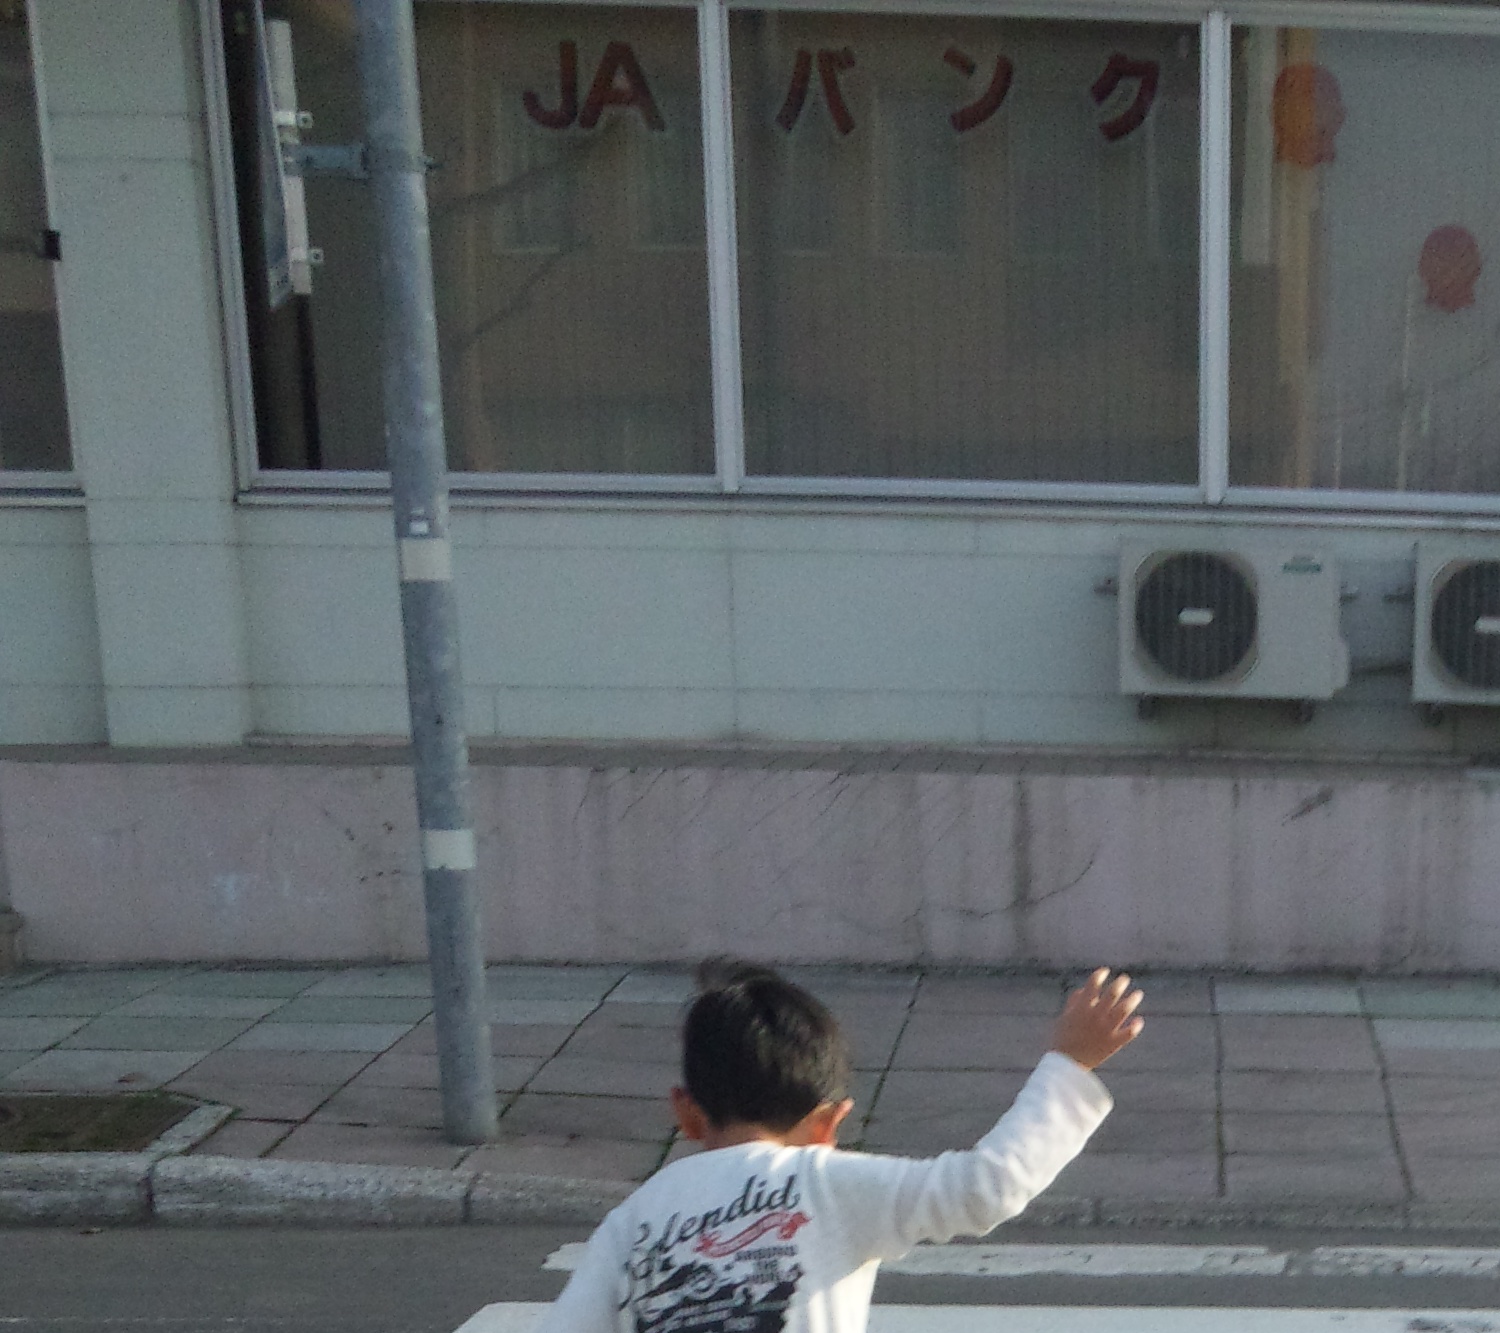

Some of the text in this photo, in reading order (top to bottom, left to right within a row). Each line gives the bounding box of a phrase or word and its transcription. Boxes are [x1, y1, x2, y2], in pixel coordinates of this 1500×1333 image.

[522, 39, 1161, 142] JA バンク
